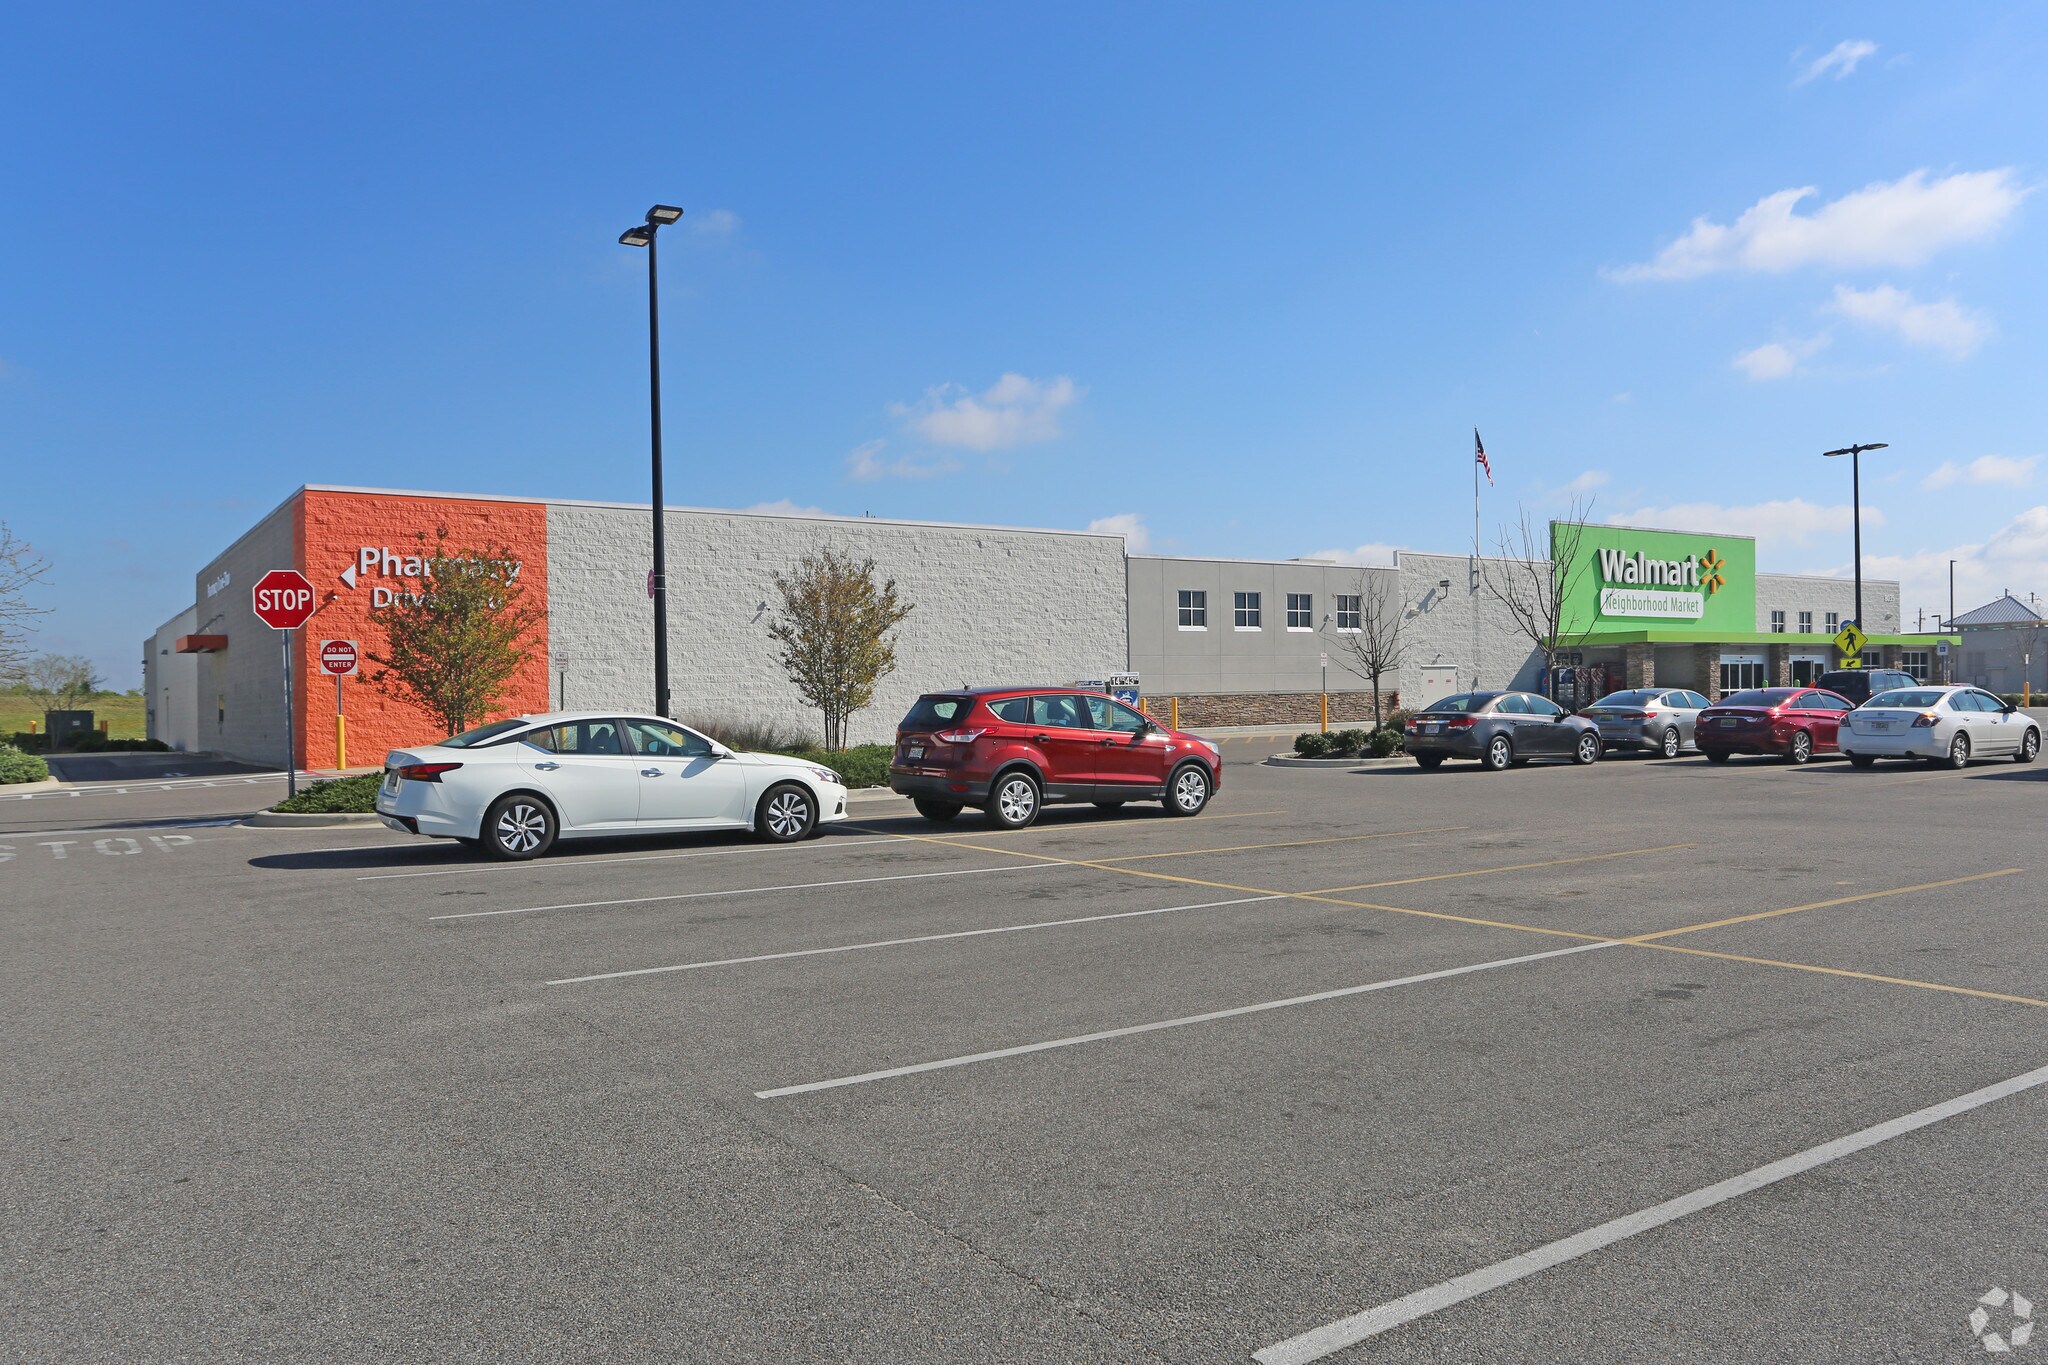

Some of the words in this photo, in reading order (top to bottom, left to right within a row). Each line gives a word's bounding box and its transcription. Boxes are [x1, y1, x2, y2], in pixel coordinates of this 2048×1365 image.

[1599, 548, 1699, 586] Walmart
[258, 589, 310, 611] STOP
[1605, 594, 1668, 613] Neighborhood
[1670, 597, 1699, 612] Market
